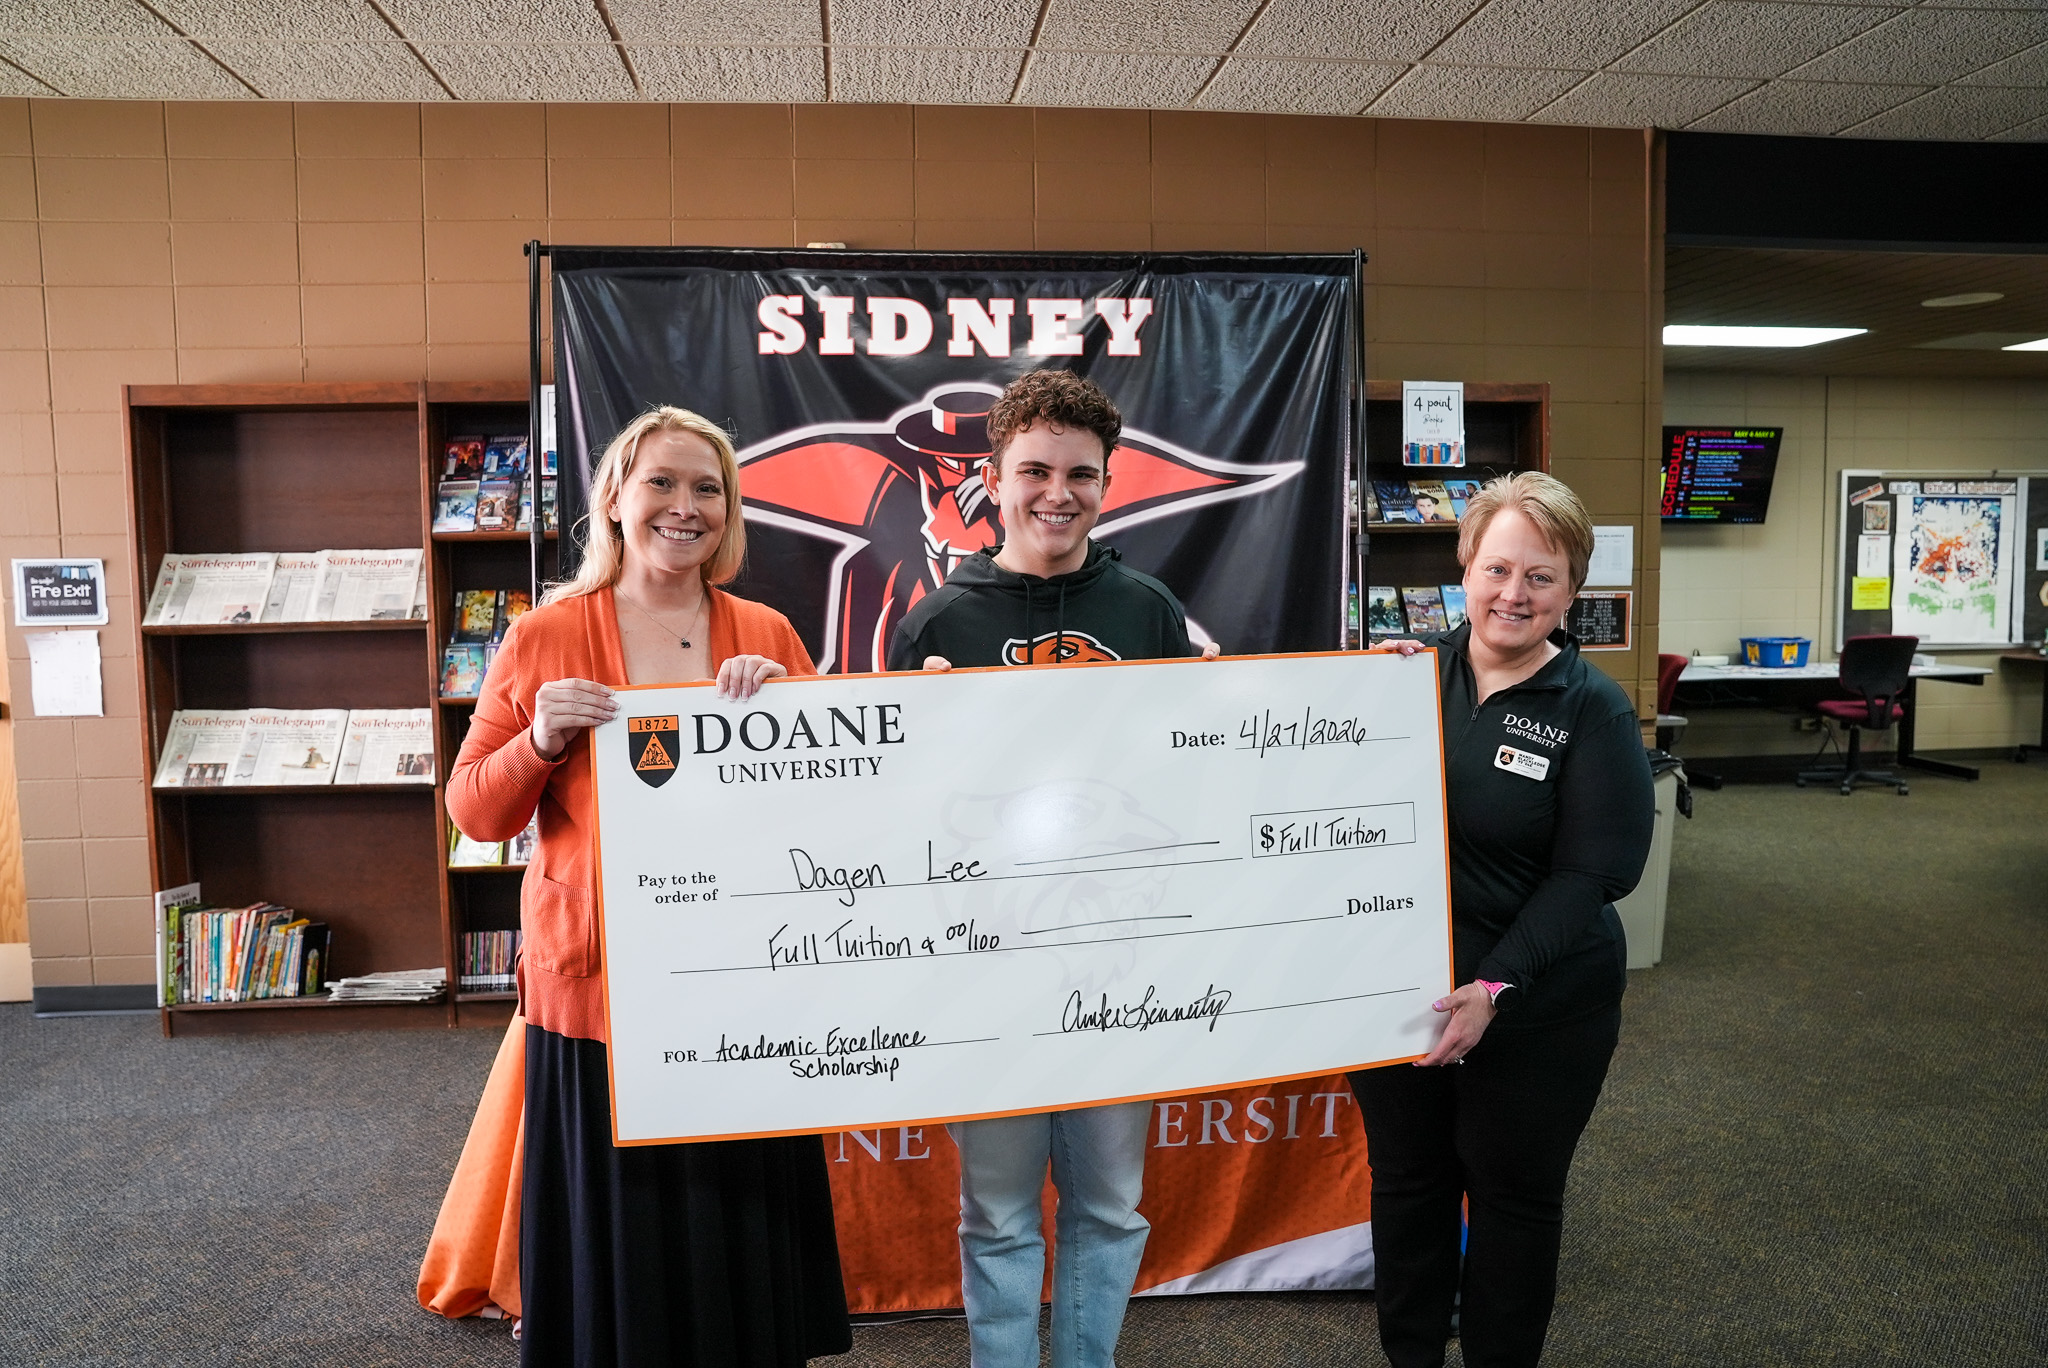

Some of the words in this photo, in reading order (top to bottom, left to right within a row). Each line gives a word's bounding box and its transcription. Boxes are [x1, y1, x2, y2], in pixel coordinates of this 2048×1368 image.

[757, 294, 1153, 357] SIDNEY
[1414, 396, 1423, 411] 4
[1427, 395, 1452, 412] point
[1661, 435, 1686, 516] SCHEDULE
[31, 584, 61, 598] Fire
[63, 584, 91, 597] Exit
[637, 718, 669, 731] 1872
[692, 704, 905, 755] DOANE
[1171, 730, 1225, 749] Date:
[1239, 706, 1367, 758] 4/27/2026
[1502, 713, 1569, 744] DOANE
[1506, 726, 1557, 749] UNIVERSITY
[717, 756, 883, 784] UNIVERSITY
[1260, 823, 1275, 852] $
[1279, 821, 1318, 854] Full
[1324, 816, 1387, 848] Tuition
[638, 874, 667, 889] Pay
[672, 874, 687, 885] to
[690, 872, 716, 885] the
[789, 848, 886, 907] Dagen
[926, 840, 988, 882] Lee
[655, 889, 699, 904] order
[702, 888, 719, 902] of
[1346, 895, 1415, 916] Dollars
[768, 924, 820, 971] Full
[825, 919, 912, 958] Tuition
[664, 1050, 698, 1063] FOR
[716, 1034, 817, 1063] Academic
[826, 1026, 926, 1057] Excellence
[1154, 1092, 1351, 1148] ERSIT
